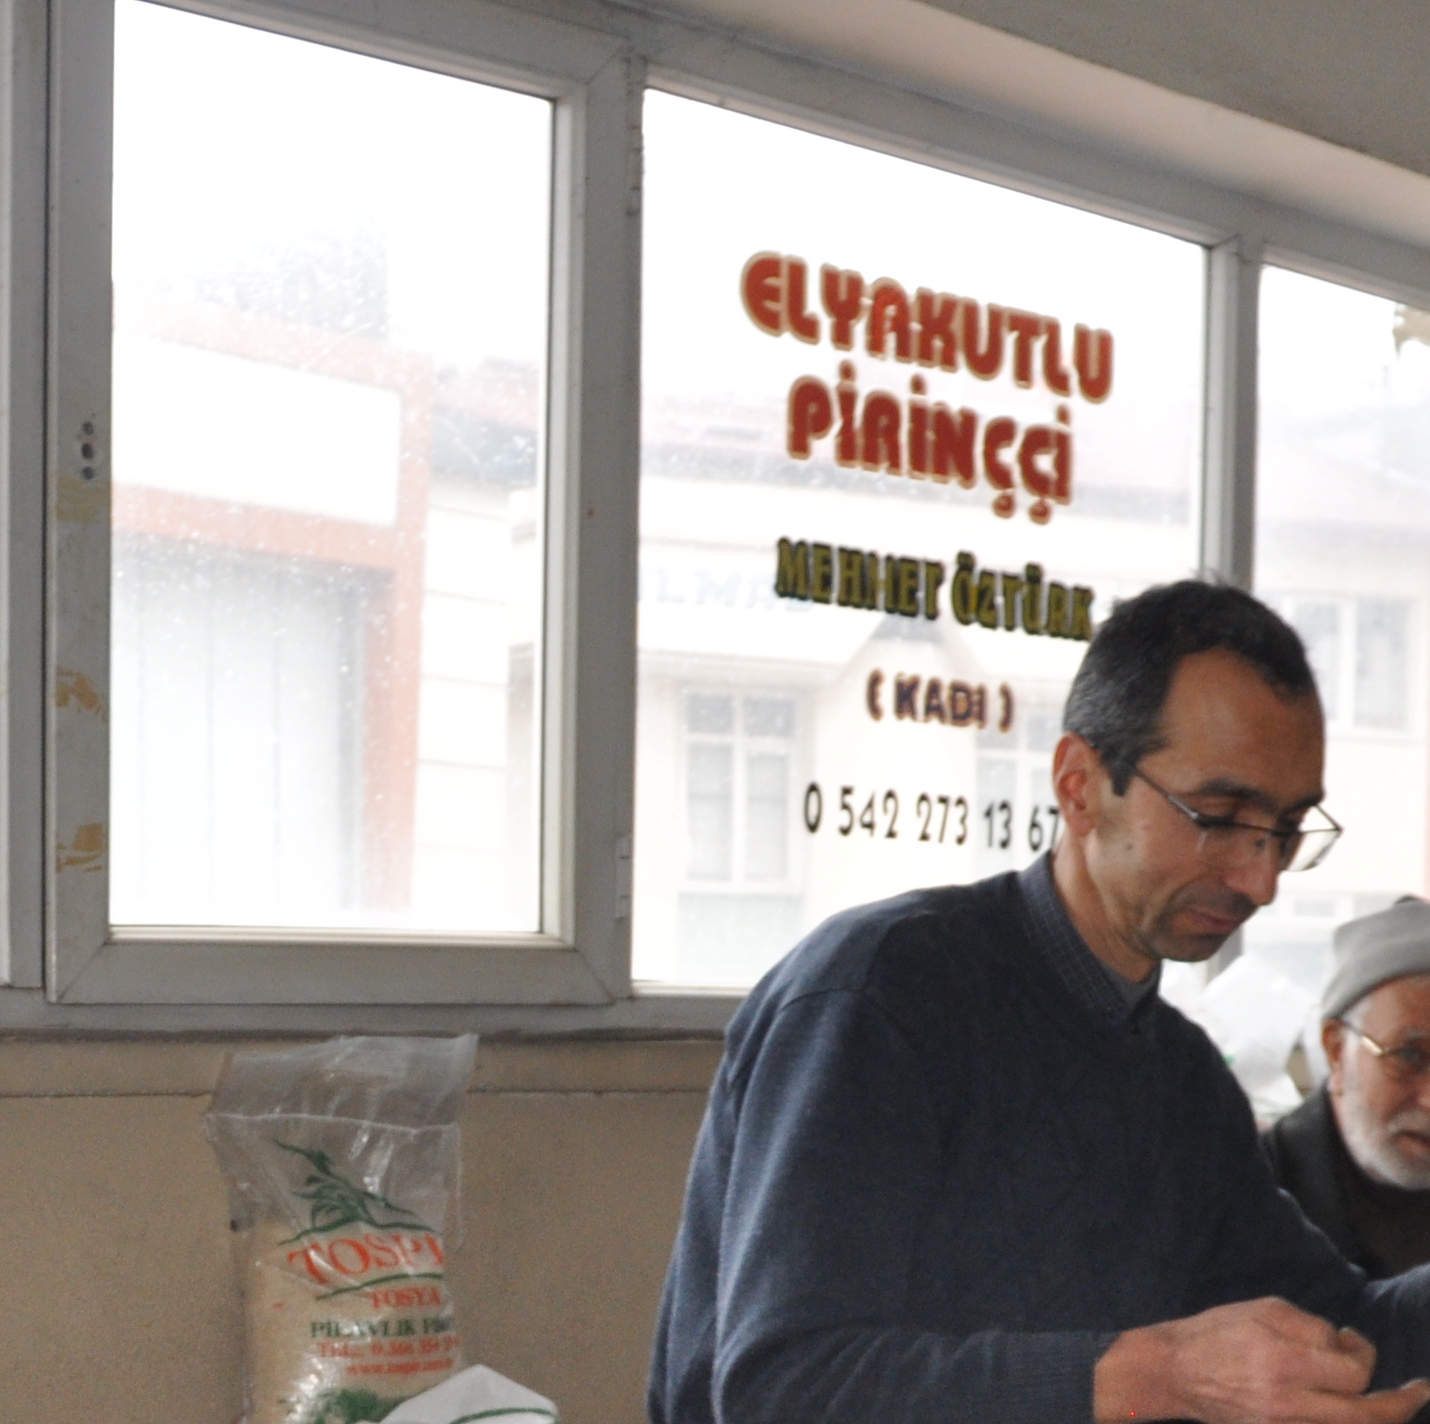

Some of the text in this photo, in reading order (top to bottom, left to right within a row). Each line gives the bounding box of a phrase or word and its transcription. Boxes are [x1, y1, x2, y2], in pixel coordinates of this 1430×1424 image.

[739, 250, 1114, 404] ELYAKUTLU
[951, 550, 1095, 642] ÖZTÜRK
[837, 785, 900, 839] 542
[916, 791, 969, 845] 273
[983, 799, 1014, 850] 13
